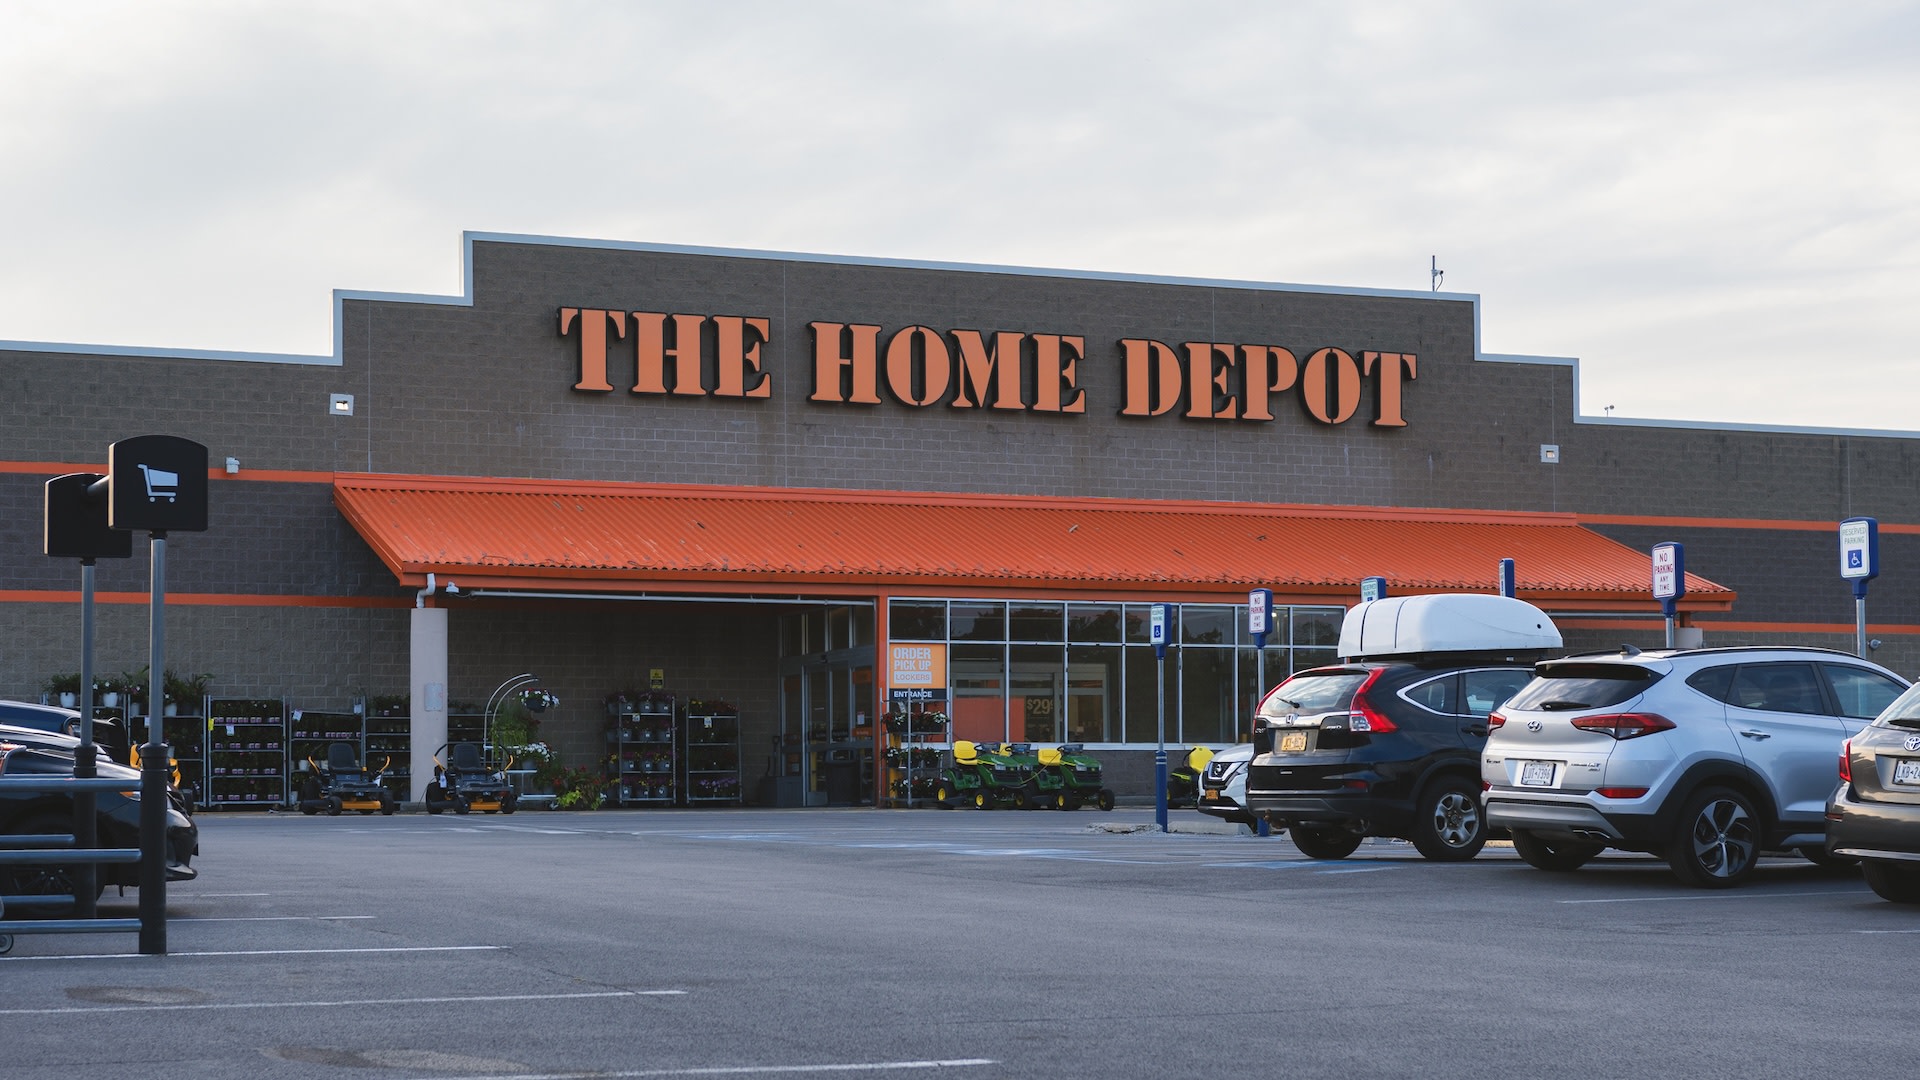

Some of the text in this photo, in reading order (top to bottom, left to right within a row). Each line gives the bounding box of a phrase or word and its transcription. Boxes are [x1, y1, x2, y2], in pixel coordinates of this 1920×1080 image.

[558, 307, 1418, 428] THE HOME DEPOT
[1844, 536, 1865, 544] PARKING
[1659, 553, 1668, 562] NO
[1655, 563, 1673, 574] PARKING
[893, 647, 932, 660] ORDER
[894, 660, 932, 670] PICK UP
[895, 673, 931, 681] LOCKERS
[893, 690, 932, 698] ENTRANCE
